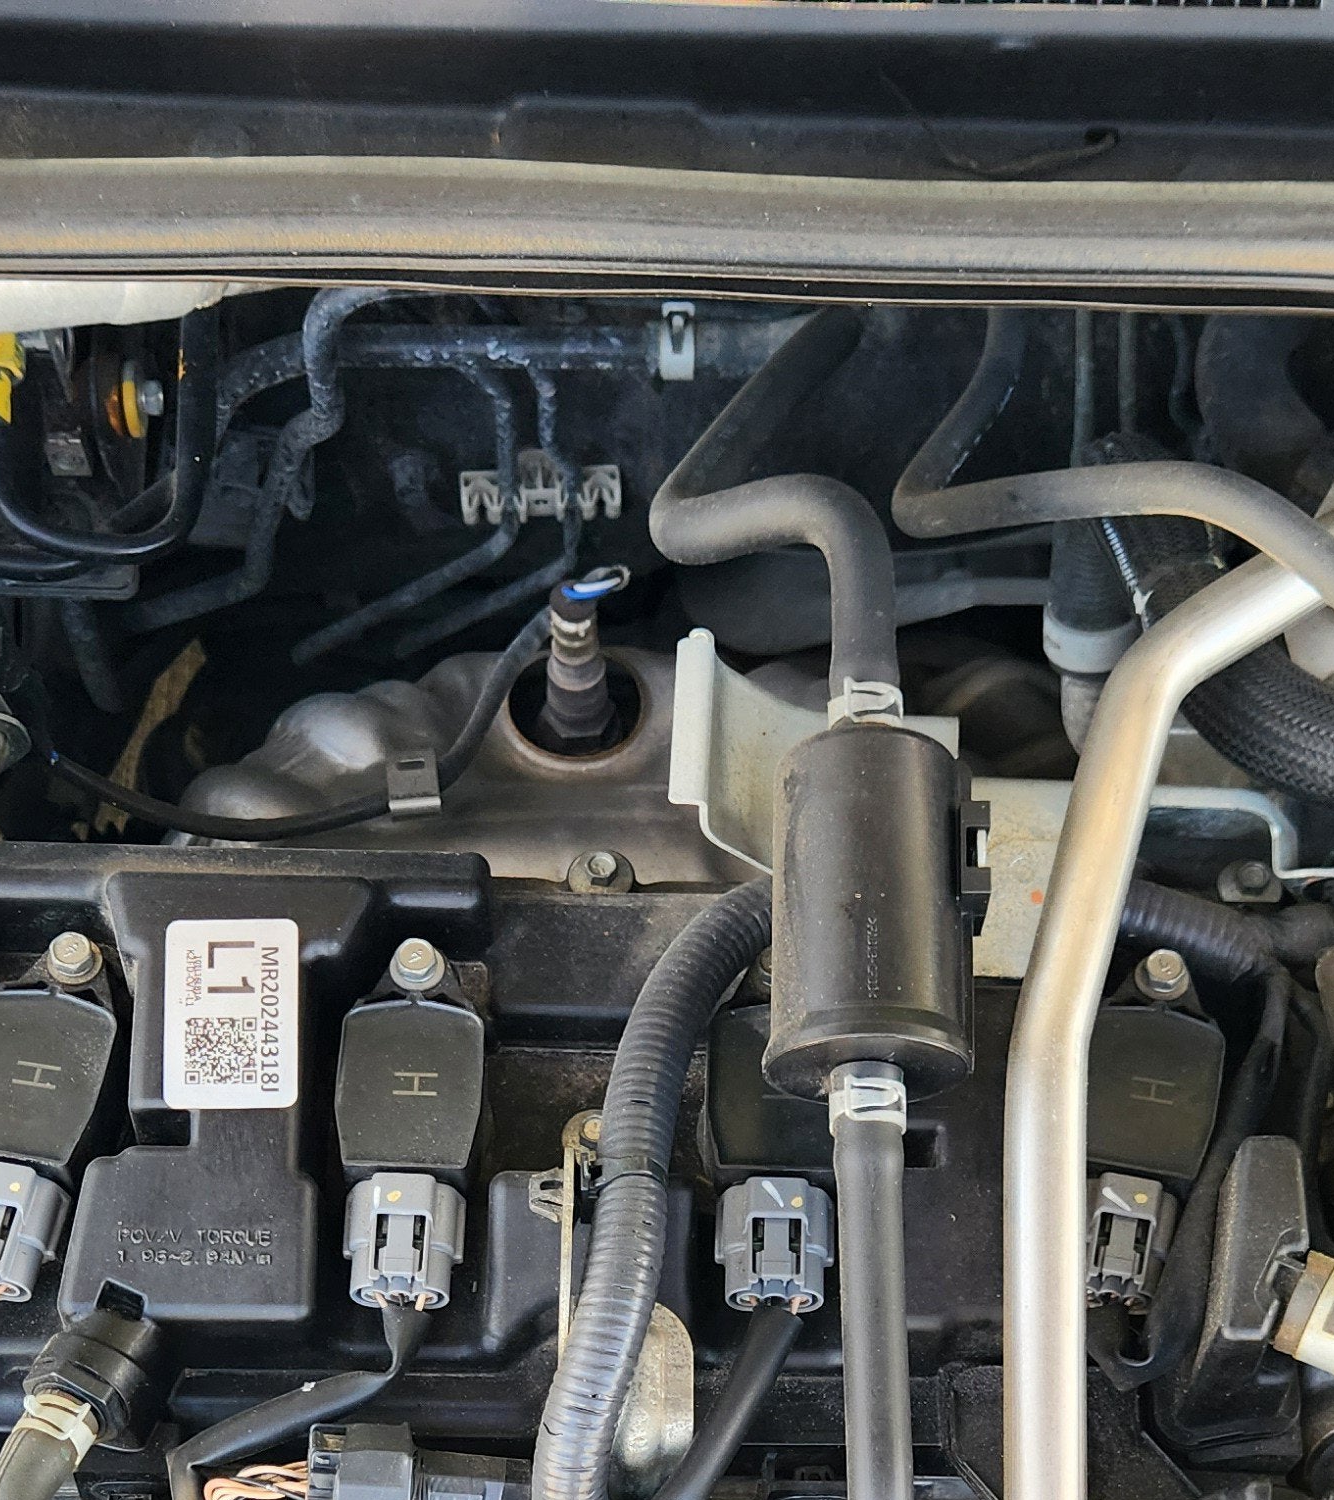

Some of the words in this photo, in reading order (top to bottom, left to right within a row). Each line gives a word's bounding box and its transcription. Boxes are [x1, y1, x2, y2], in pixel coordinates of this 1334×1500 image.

[207, 940, 256, 994] L1
[260, 946, 280, 1092] MR20244318J
[12, 1060, 61, 1091] H
[392, 1070, 440, 1098] H
[1134, 1076, 1176, 1105] H
